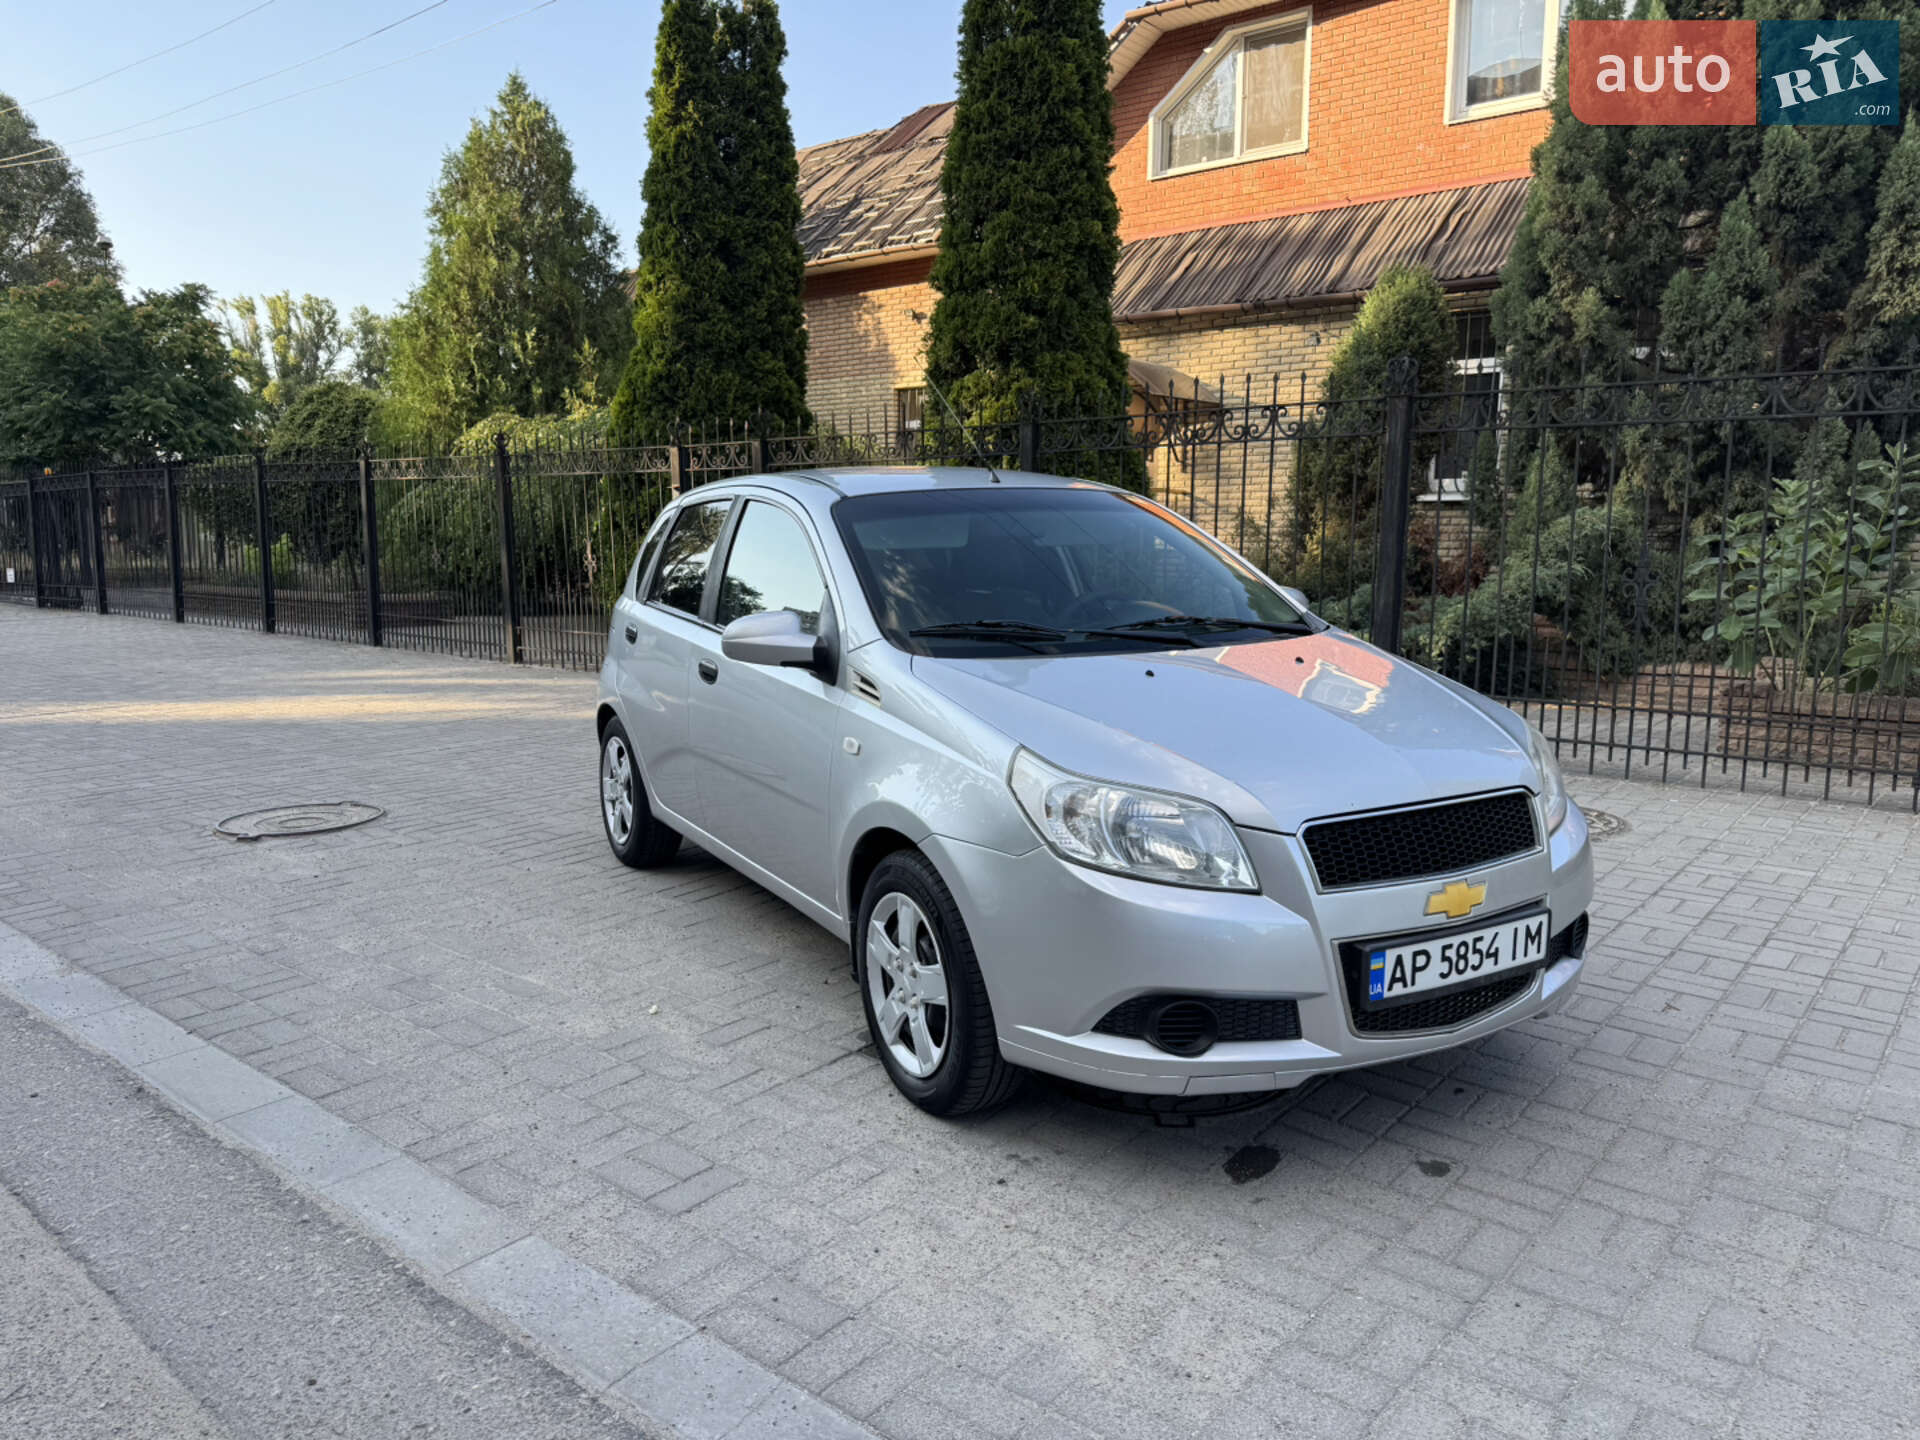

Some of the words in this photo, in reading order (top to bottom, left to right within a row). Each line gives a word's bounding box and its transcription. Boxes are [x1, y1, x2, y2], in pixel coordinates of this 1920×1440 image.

[1387, 949, 1431, 992] AP
[1439, 932, 1499, 980] 5854
[1512, 920, 1543, 961] IM
[1370, 983, 1383, 995] UA
